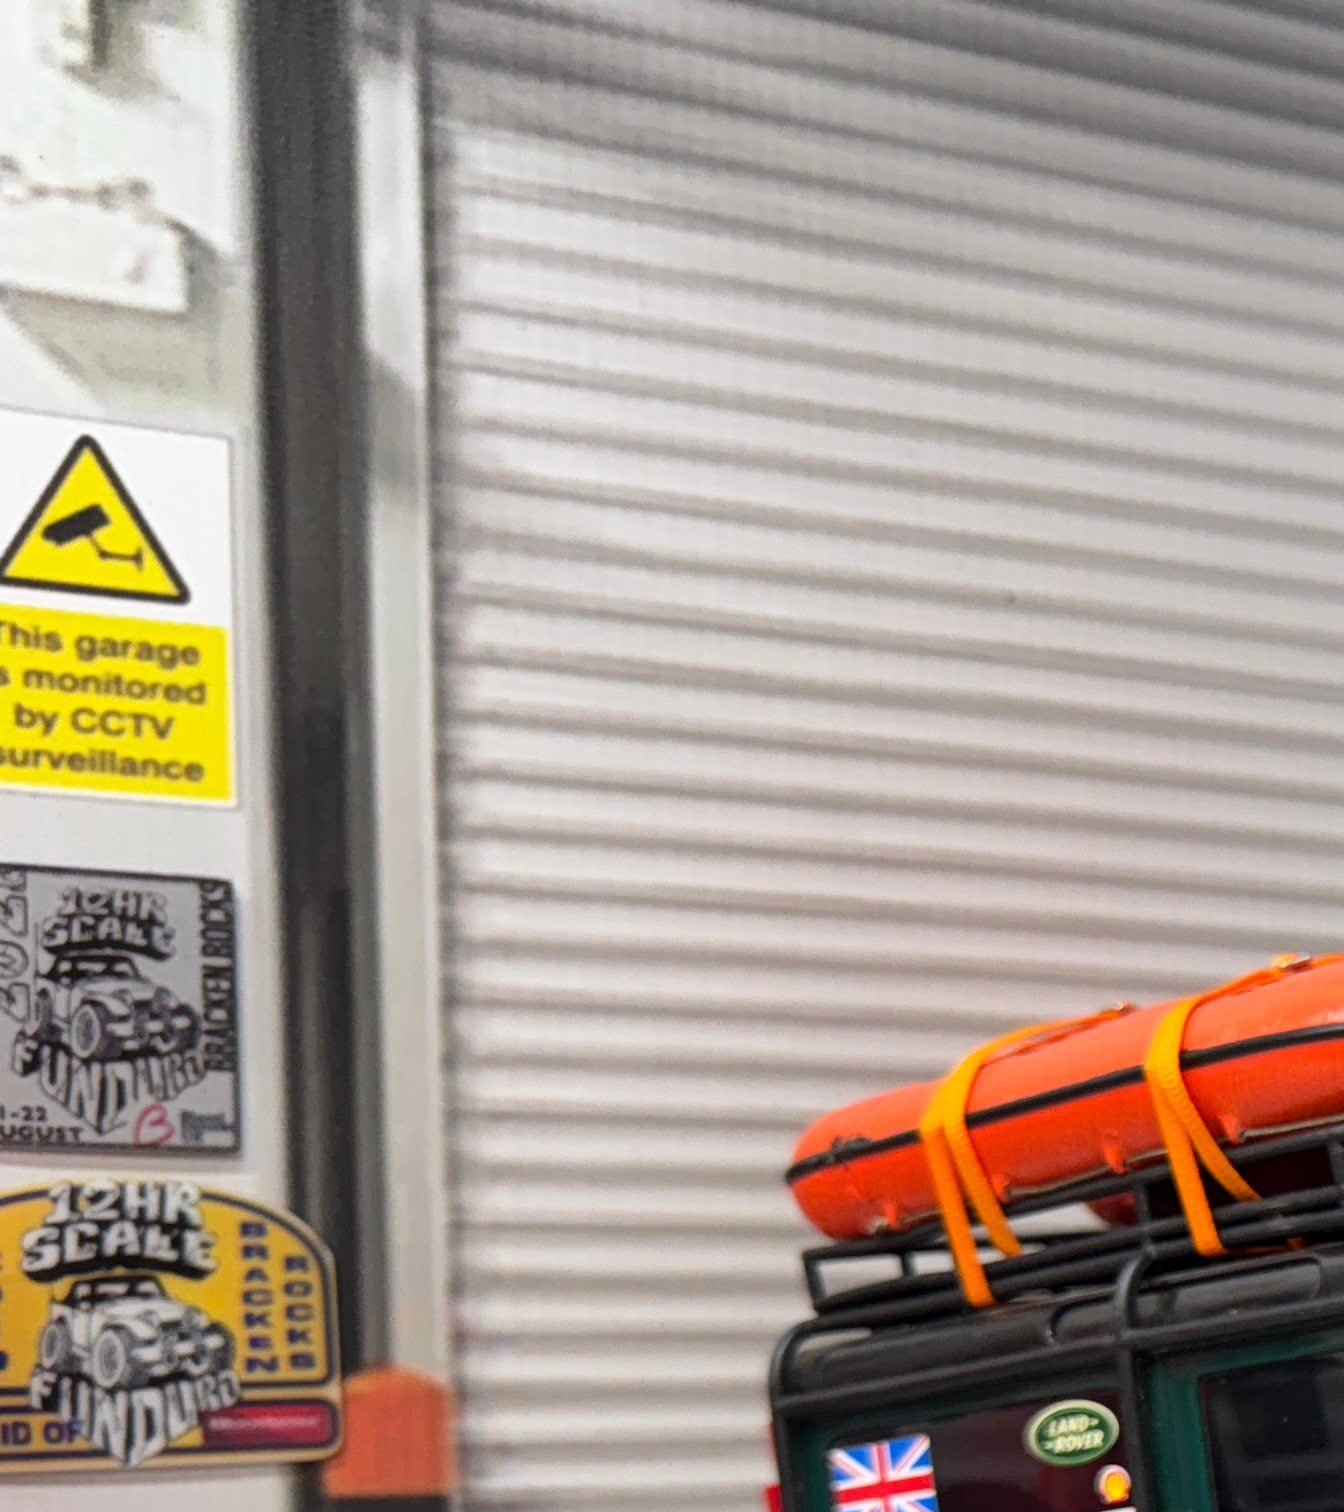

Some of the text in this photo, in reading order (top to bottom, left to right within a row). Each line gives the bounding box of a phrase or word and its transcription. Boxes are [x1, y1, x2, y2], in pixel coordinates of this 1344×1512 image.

[75, 635, 200, 670] garage
[23, 669, 207, 705] monitored
[14, 702, 175, 740] by CCTV
[60, 886, 167, 926] 12HR
[41, 915, 176, 957] SCALE
[45, 1179, 203, 1226] 12HR
[21, 1222, 218, 1276] SCALE
[1048, 1414, 1089, 1437] LAND
[1055, 1429, 1104, 1454] ROVER
